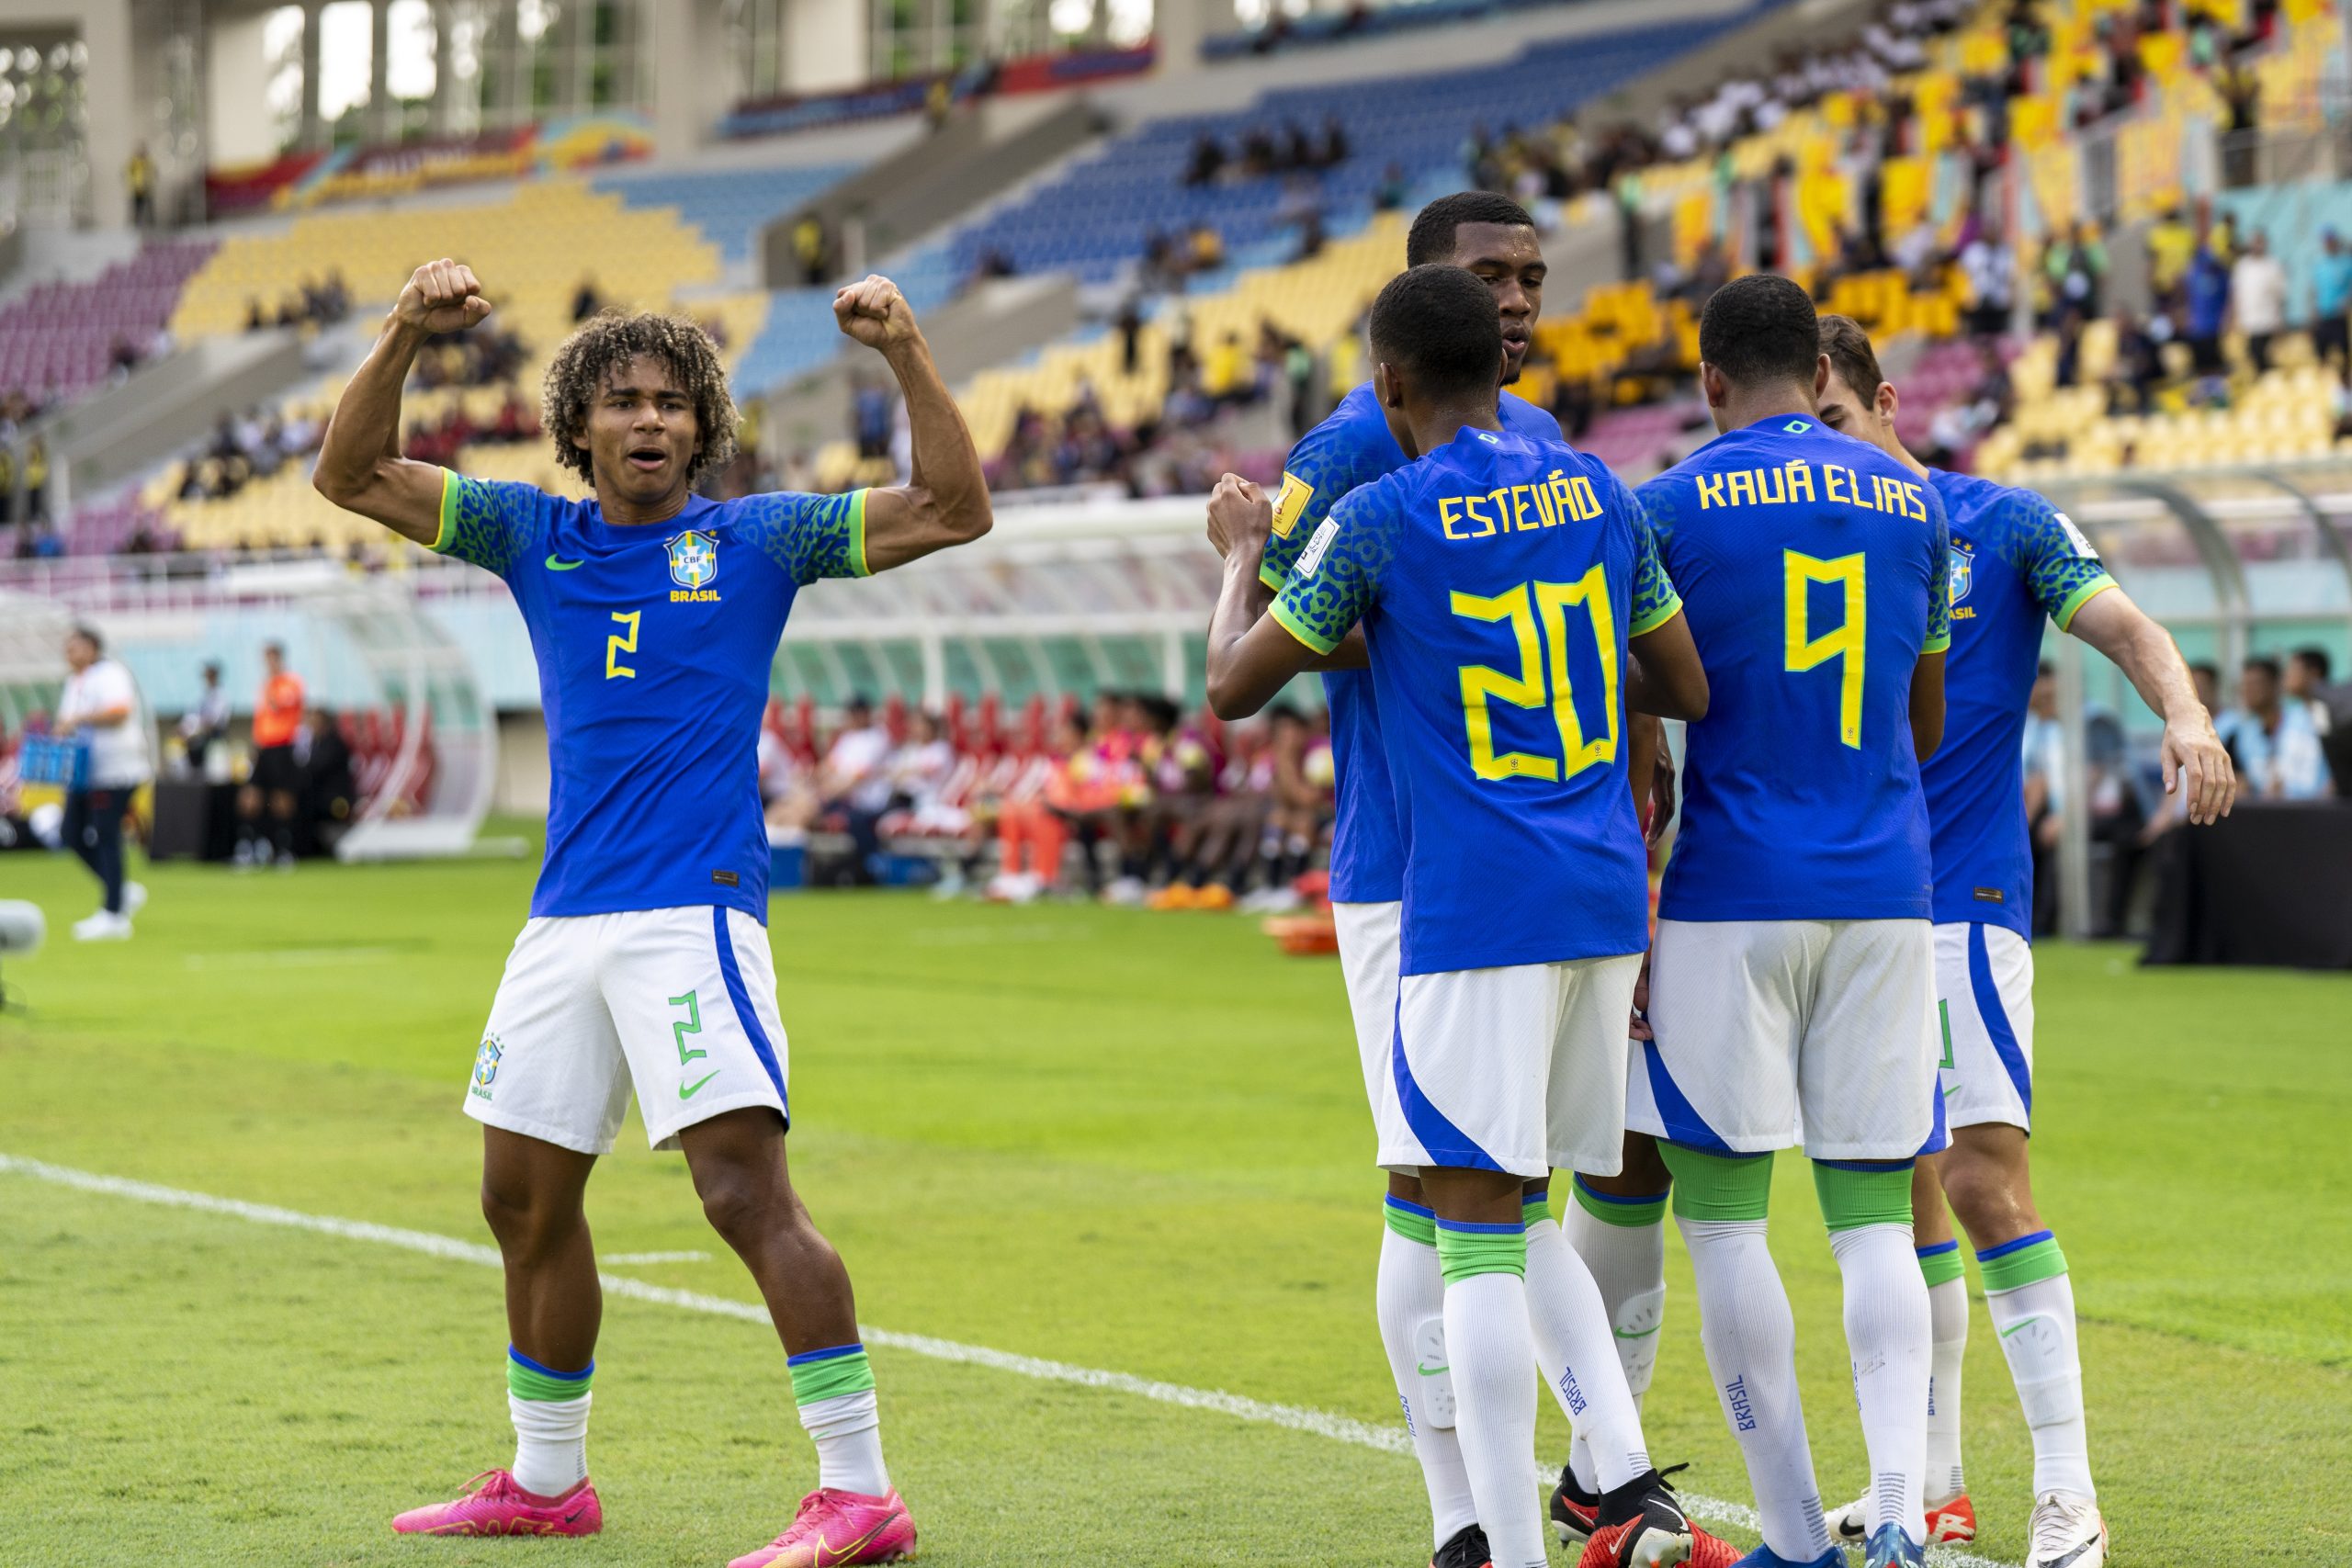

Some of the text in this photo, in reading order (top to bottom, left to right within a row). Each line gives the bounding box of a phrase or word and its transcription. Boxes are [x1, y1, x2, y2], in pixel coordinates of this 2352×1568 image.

[1695, 459, 1928, 523] KAUÁ ELIAS
[683, 556, 702, 564] CBF
[670, 590, 721, 603] BRASIL
[1949, 606, 1977, 620] ASIL
[605, 610, 641, 680] 2
[1449, 561, 1619, 783] 20
[1783, 547, 1866, 750] 9
[668, 989, 707, 1066] 2
[1559, 1366, 1588, 1416] BRASIL
[1725, 1374, 1757, 1431] BRASIL
